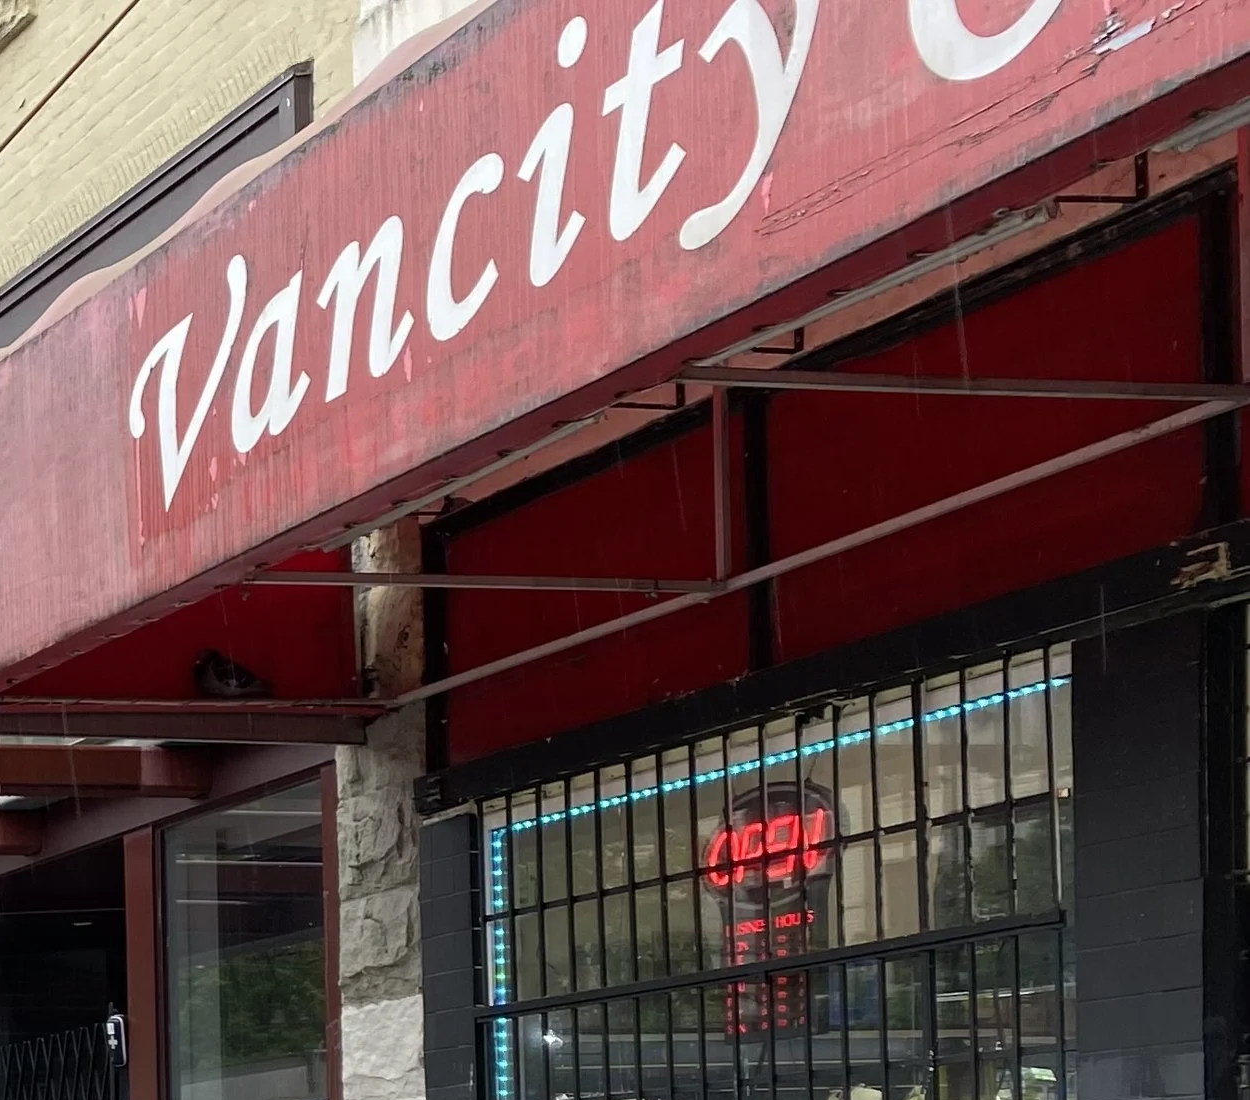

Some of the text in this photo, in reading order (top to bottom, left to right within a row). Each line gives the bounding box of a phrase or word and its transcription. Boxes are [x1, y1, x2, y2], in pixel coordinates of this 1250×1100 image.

[130, 0, 822, 512] Vancity
[707, 808, 825, 886] OPEN
[775, 911, 815, 929] HOUS
